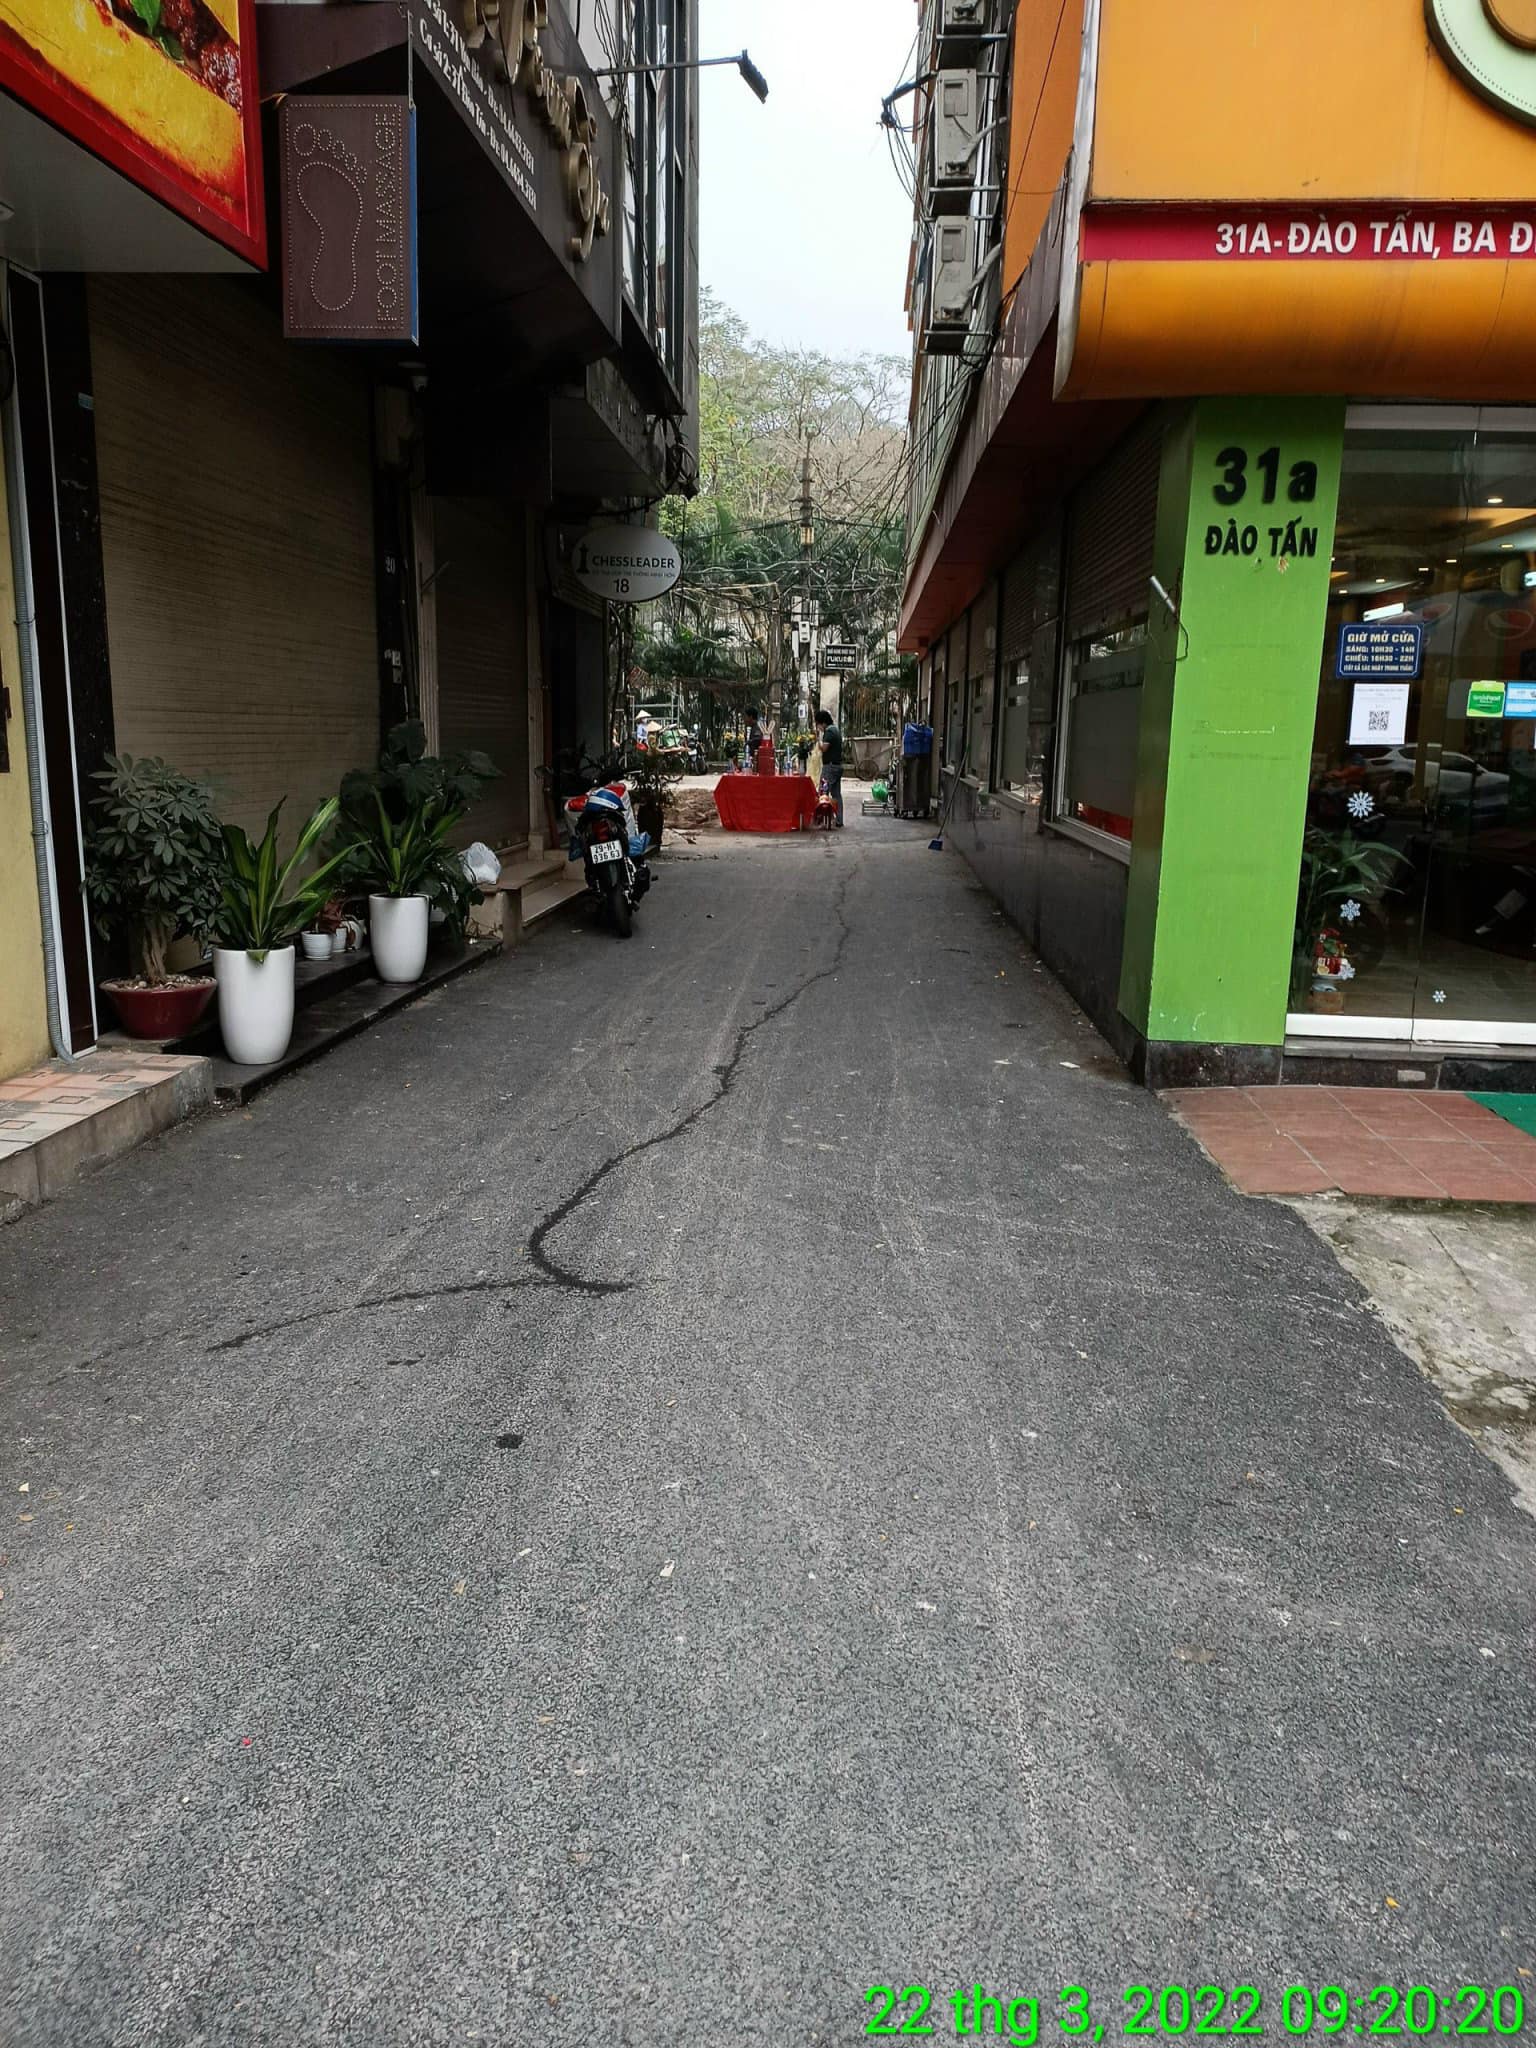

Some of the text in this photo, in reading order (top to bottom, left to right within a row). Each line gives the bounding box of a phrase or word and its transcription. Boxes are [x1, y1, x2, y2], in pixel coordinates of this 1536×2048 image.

[374, 112, 398, 321] FOOT MASSAGE
[1369, 208, 1441, 260] TẤN,
[1452, 221, 1497, 254] BA
[1509, 221, 1536, 255] Đ
[1213, 447, 1318, 506] 31a
[1205, 515, 1319, 558] ĐÀO TẤN
[592, 554, 676, 569] CHESSLEADER
[613, 578, 630, 593] 18
[1347, 629, 1415, 643] GIỜ MỞ CỬA
